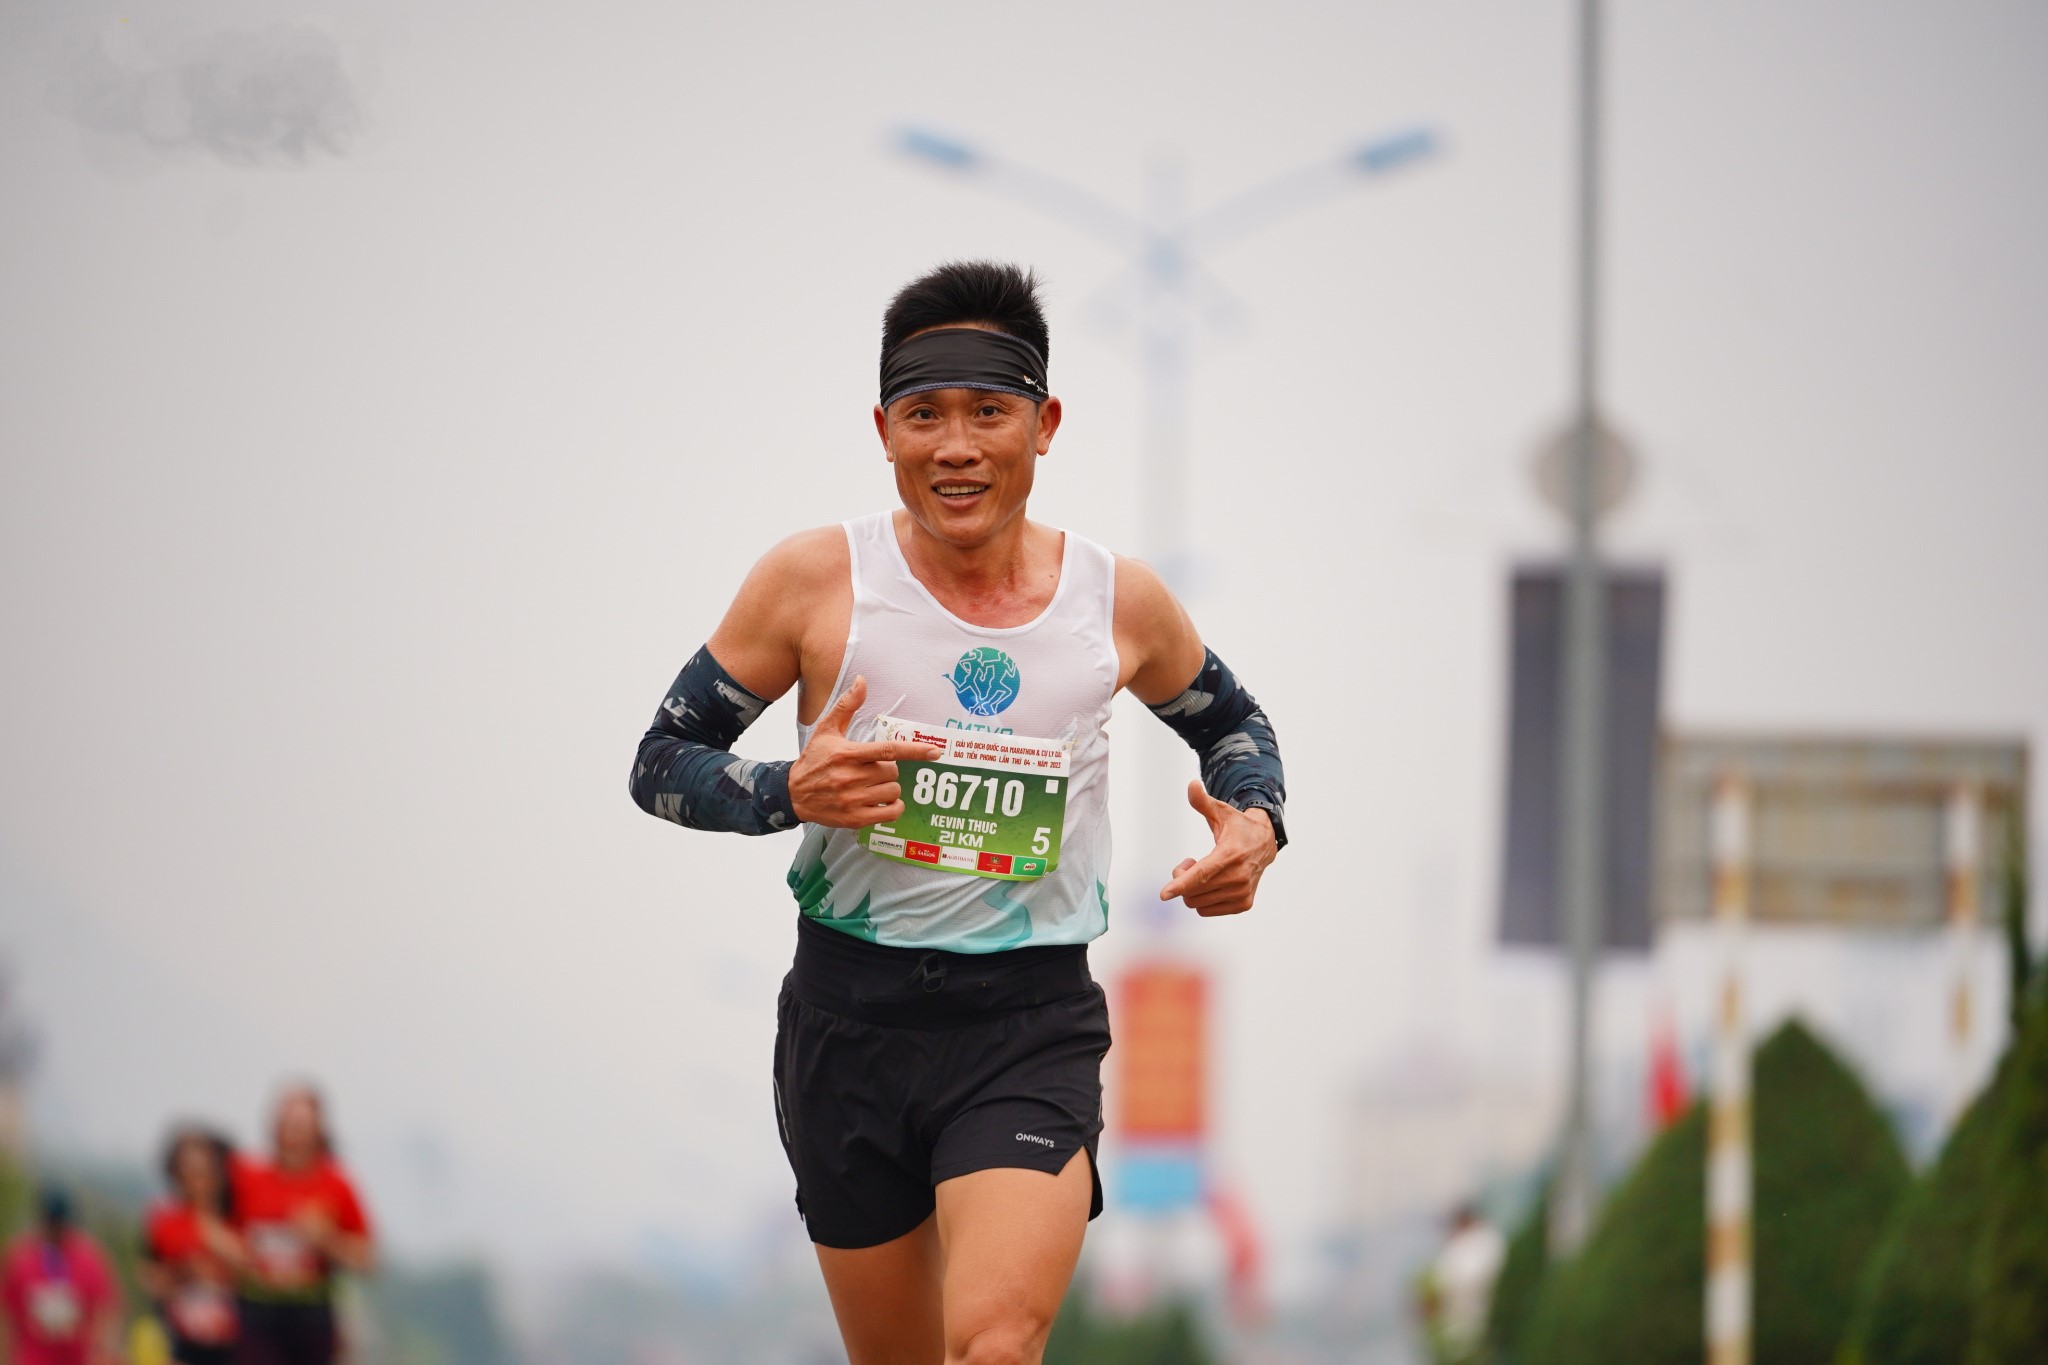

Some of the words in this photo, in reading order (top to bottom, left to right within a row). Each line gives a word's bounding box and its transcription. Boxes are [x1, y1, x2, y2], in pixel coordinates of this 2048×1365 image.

[979, 753, 997, 762] PHONG
[1000, 745, 1009, 753] GIA
[1010, 746, 1036, 756] MARATHON
[912, 767, 1025, 817] 86710
[930, 814, 965, 830] KEVIN
[968, 818, 998, 835] THUC
[938, 830, 955, 844] 21
[957, 832, 984, 848] KM
[1031, 826, 1052, 856] 5
[1015, 1132, 1055, 1148] ONWAYS
